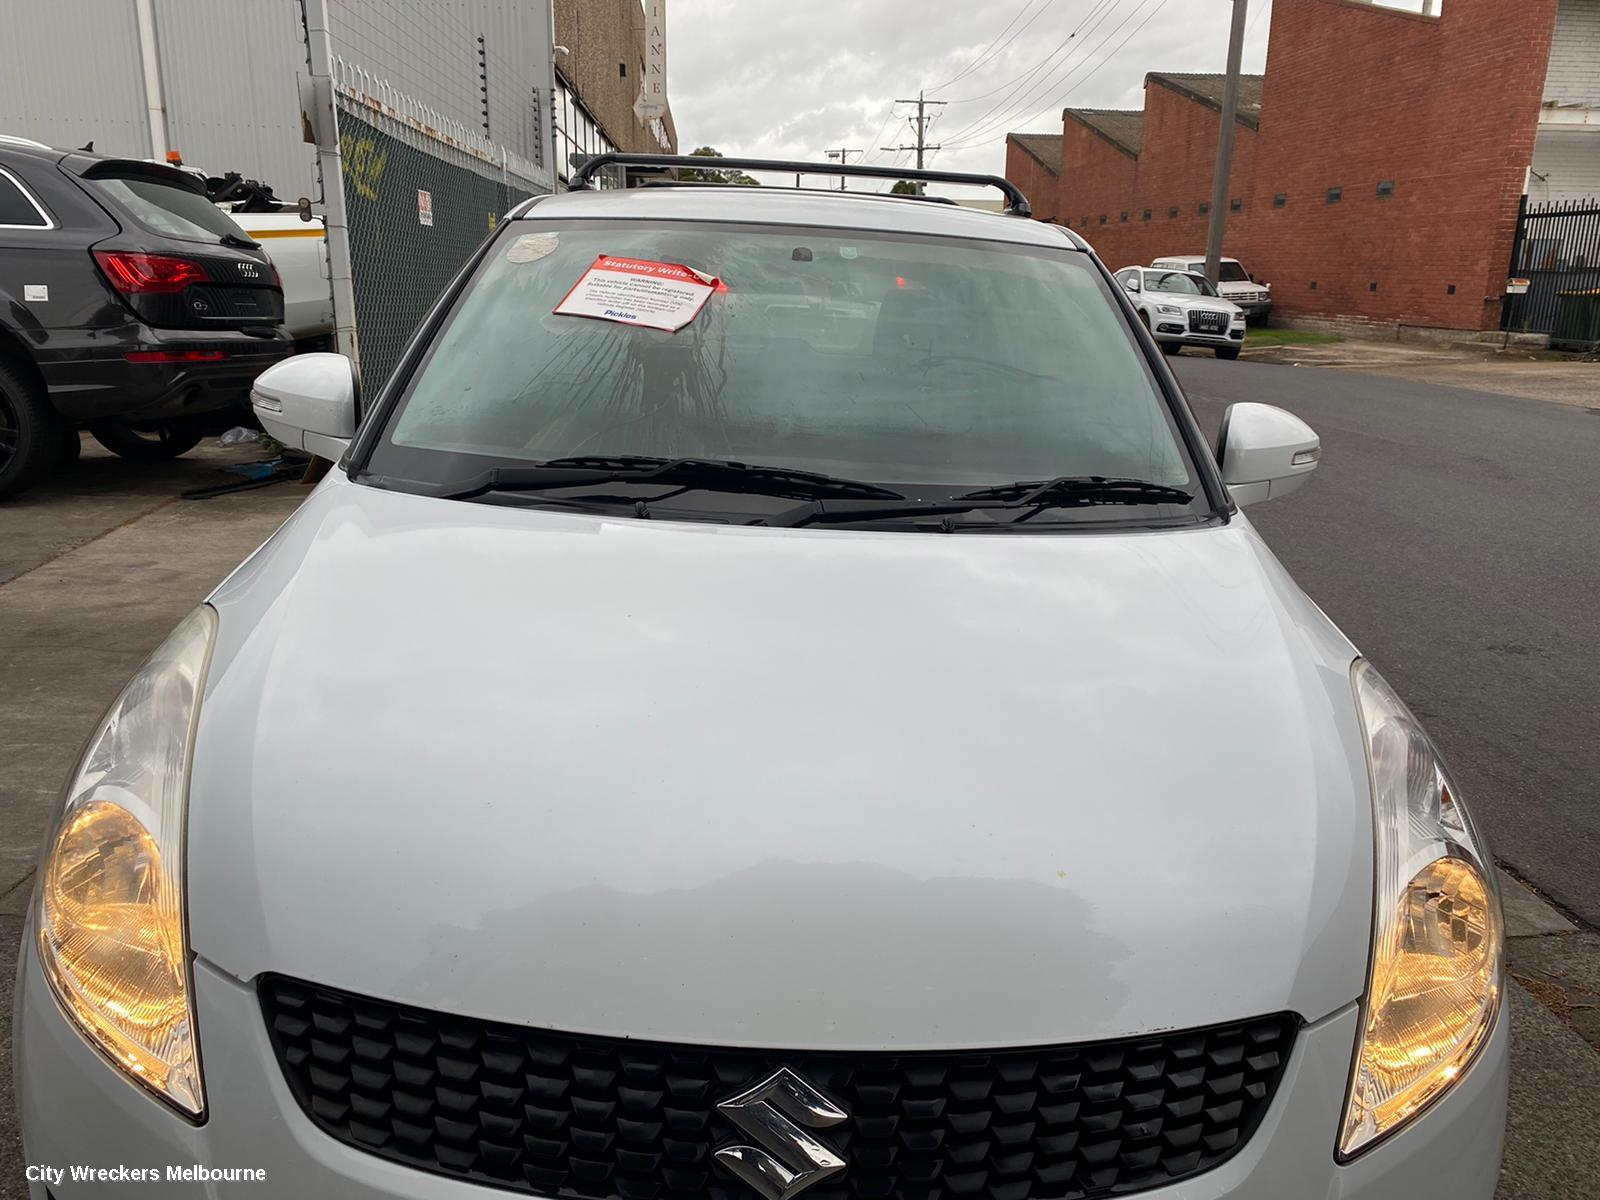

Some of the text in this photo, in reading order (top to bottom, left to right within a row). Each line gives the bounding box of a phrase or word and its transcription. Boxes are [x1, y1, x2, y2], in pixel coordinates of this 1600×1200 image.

[603, 260, 655, 273] Statutory
[193, 301, 208, 311] Q7
[604, 309, 637, 320] Pickles
